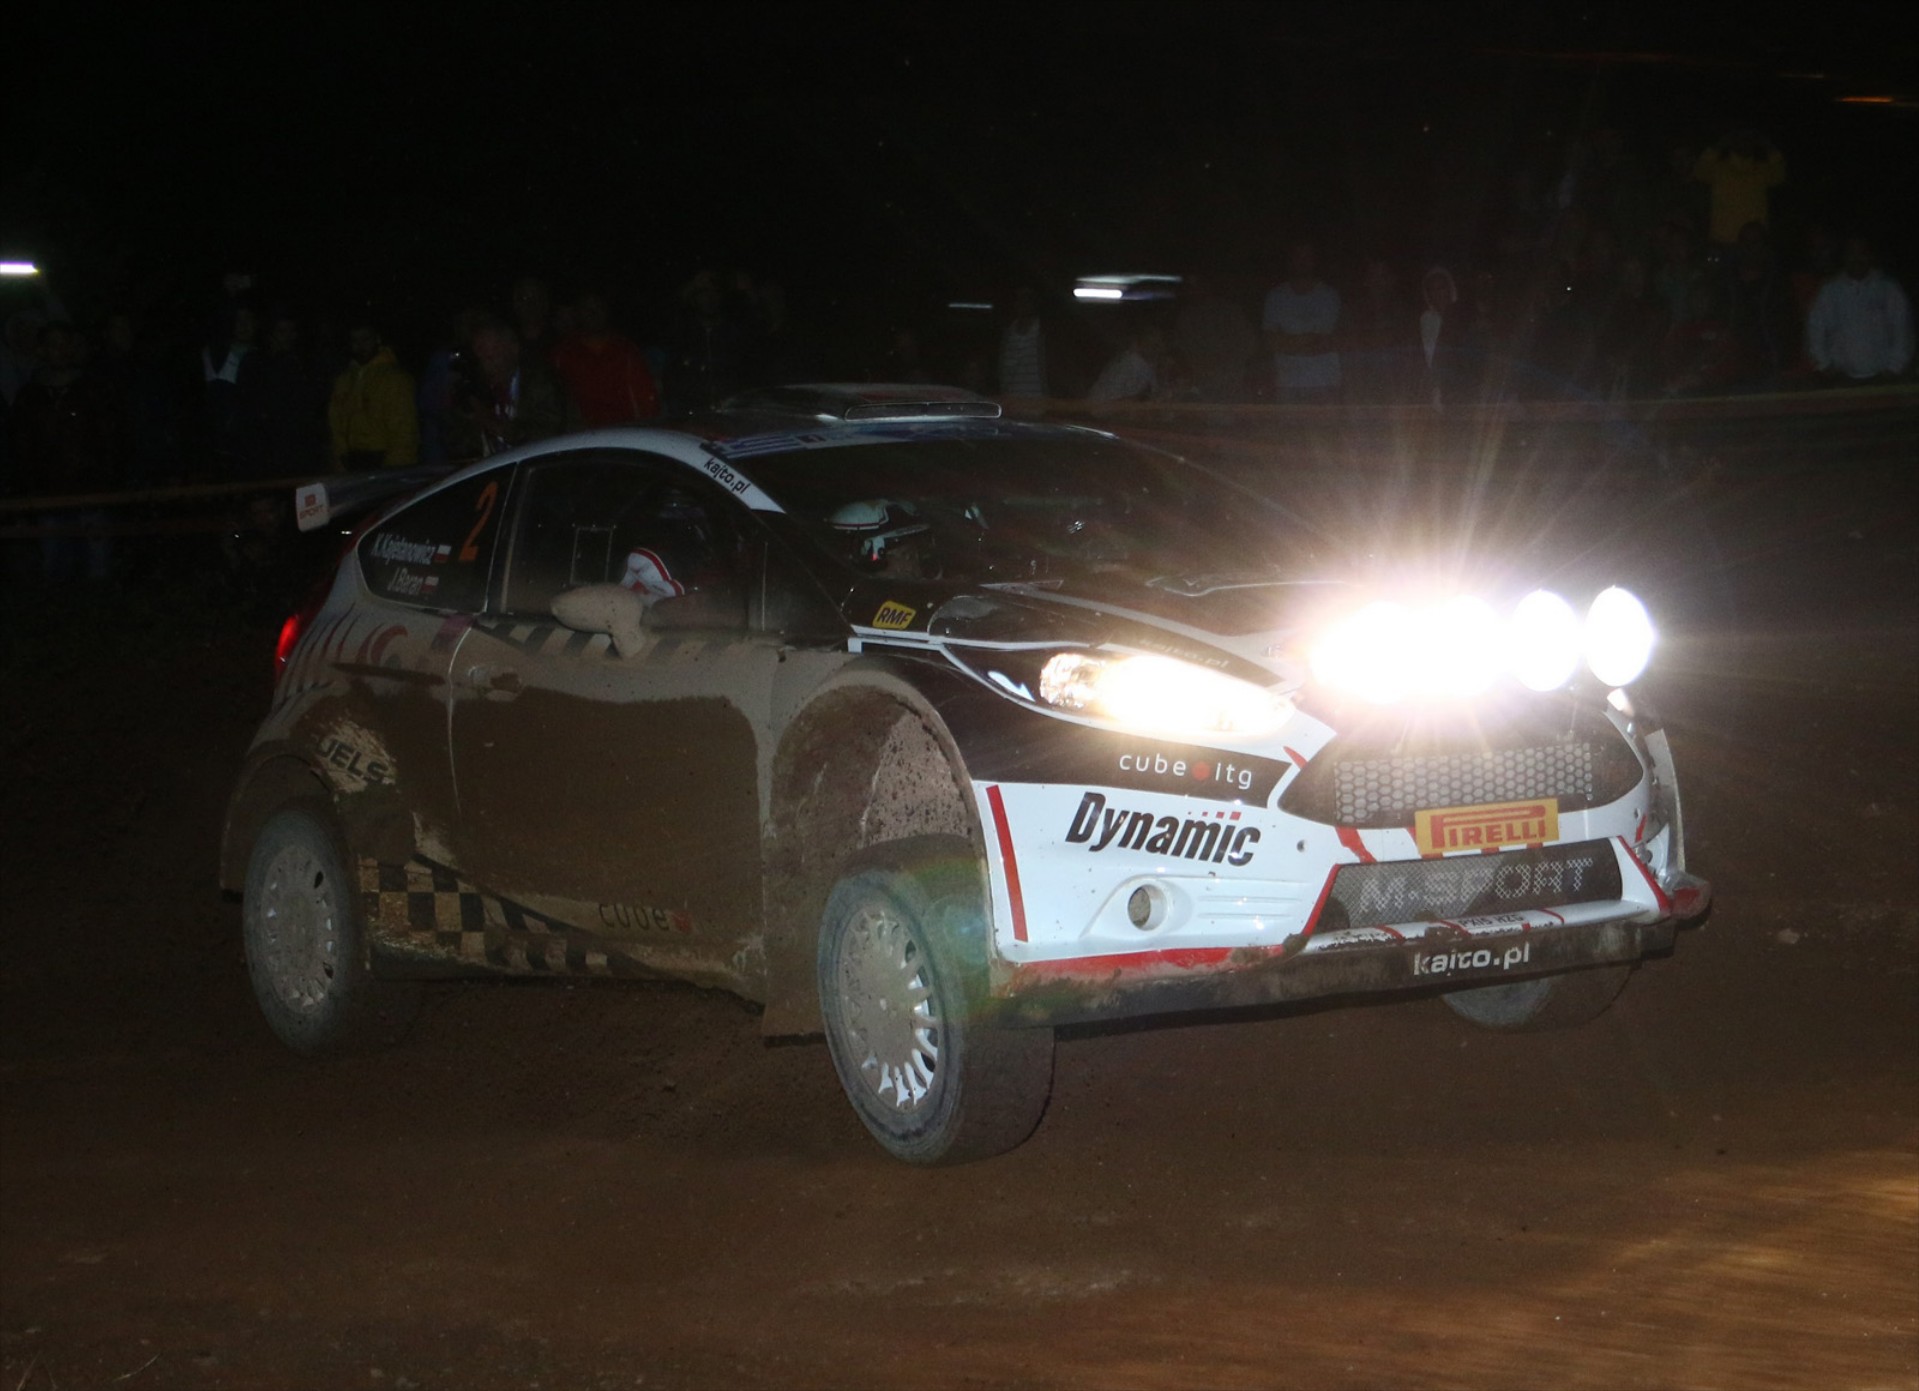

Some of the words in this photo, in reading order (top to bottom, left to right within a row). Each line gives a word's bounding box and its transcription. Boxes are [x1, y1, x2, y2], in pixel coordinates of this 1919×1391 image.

[704, 457, 751, 494] kajto.pl
[459, 481, 498, 562] 2
[877, 607, 912, 625] RMF
[1065, 791, 1261, 867] Dynamic
[1430, 804, 1546, 849] PIRELLI
